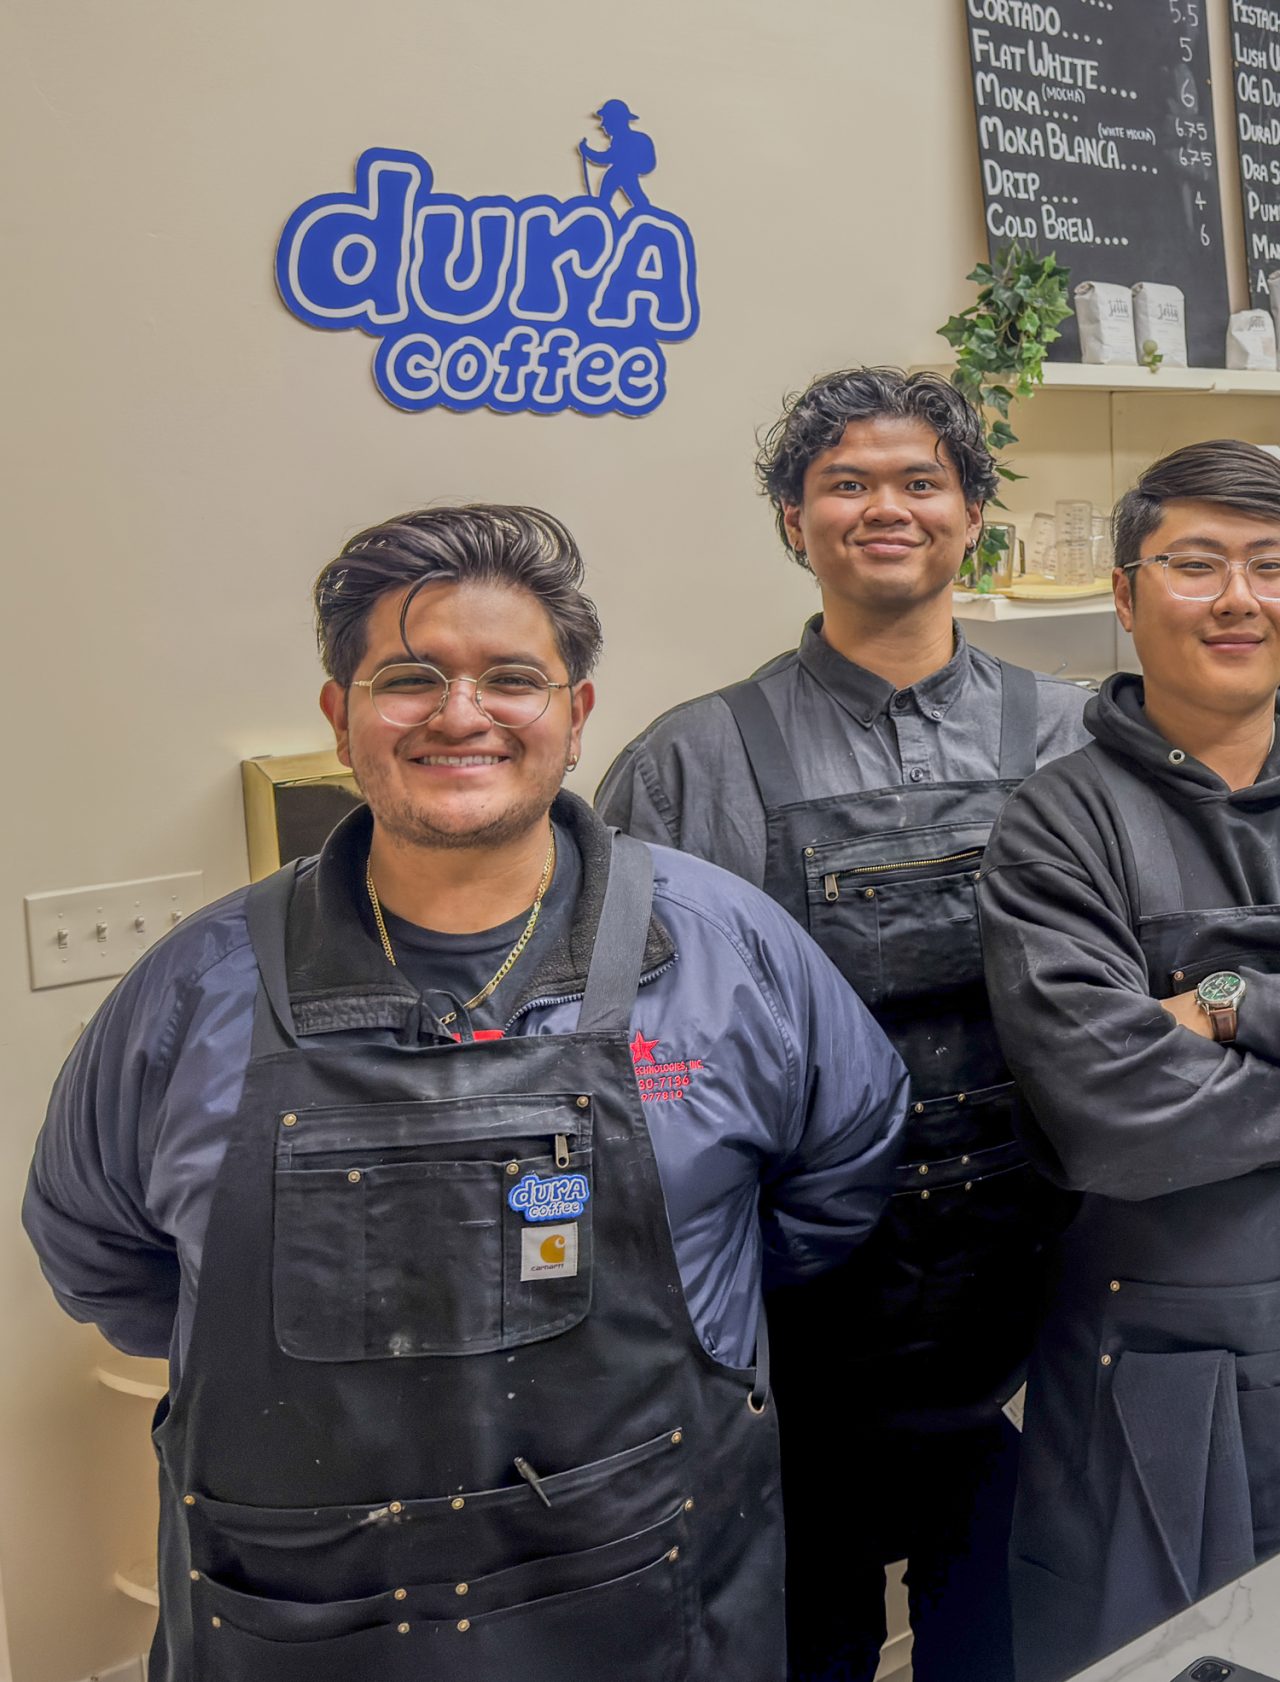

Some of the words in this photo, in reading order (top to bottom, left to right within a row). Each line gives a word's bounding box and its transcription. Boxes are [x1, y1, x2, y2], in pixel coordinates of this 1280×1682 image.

[1180, 36, 1193, 62] 5
[1234, 32, 1268, 69] LUSH
[972, 28, 1026, 72] FLAT
[1181, 79, 1195, 107] 6
[1237, 71, 1260, 103] OG
[980, 115, 1045, 157] MOKA
[1239, 112, 1271, 145] DURA
[1242, 154, 1269, 182] DRA
[1194, 191, 1207, 211] 4
[986, 202, 1037, 238] COLD
[1199, 224, 1210, 246] 6
[386, 325, 660, 407] coffee
[529, 1201, 580, 1218] coffee
